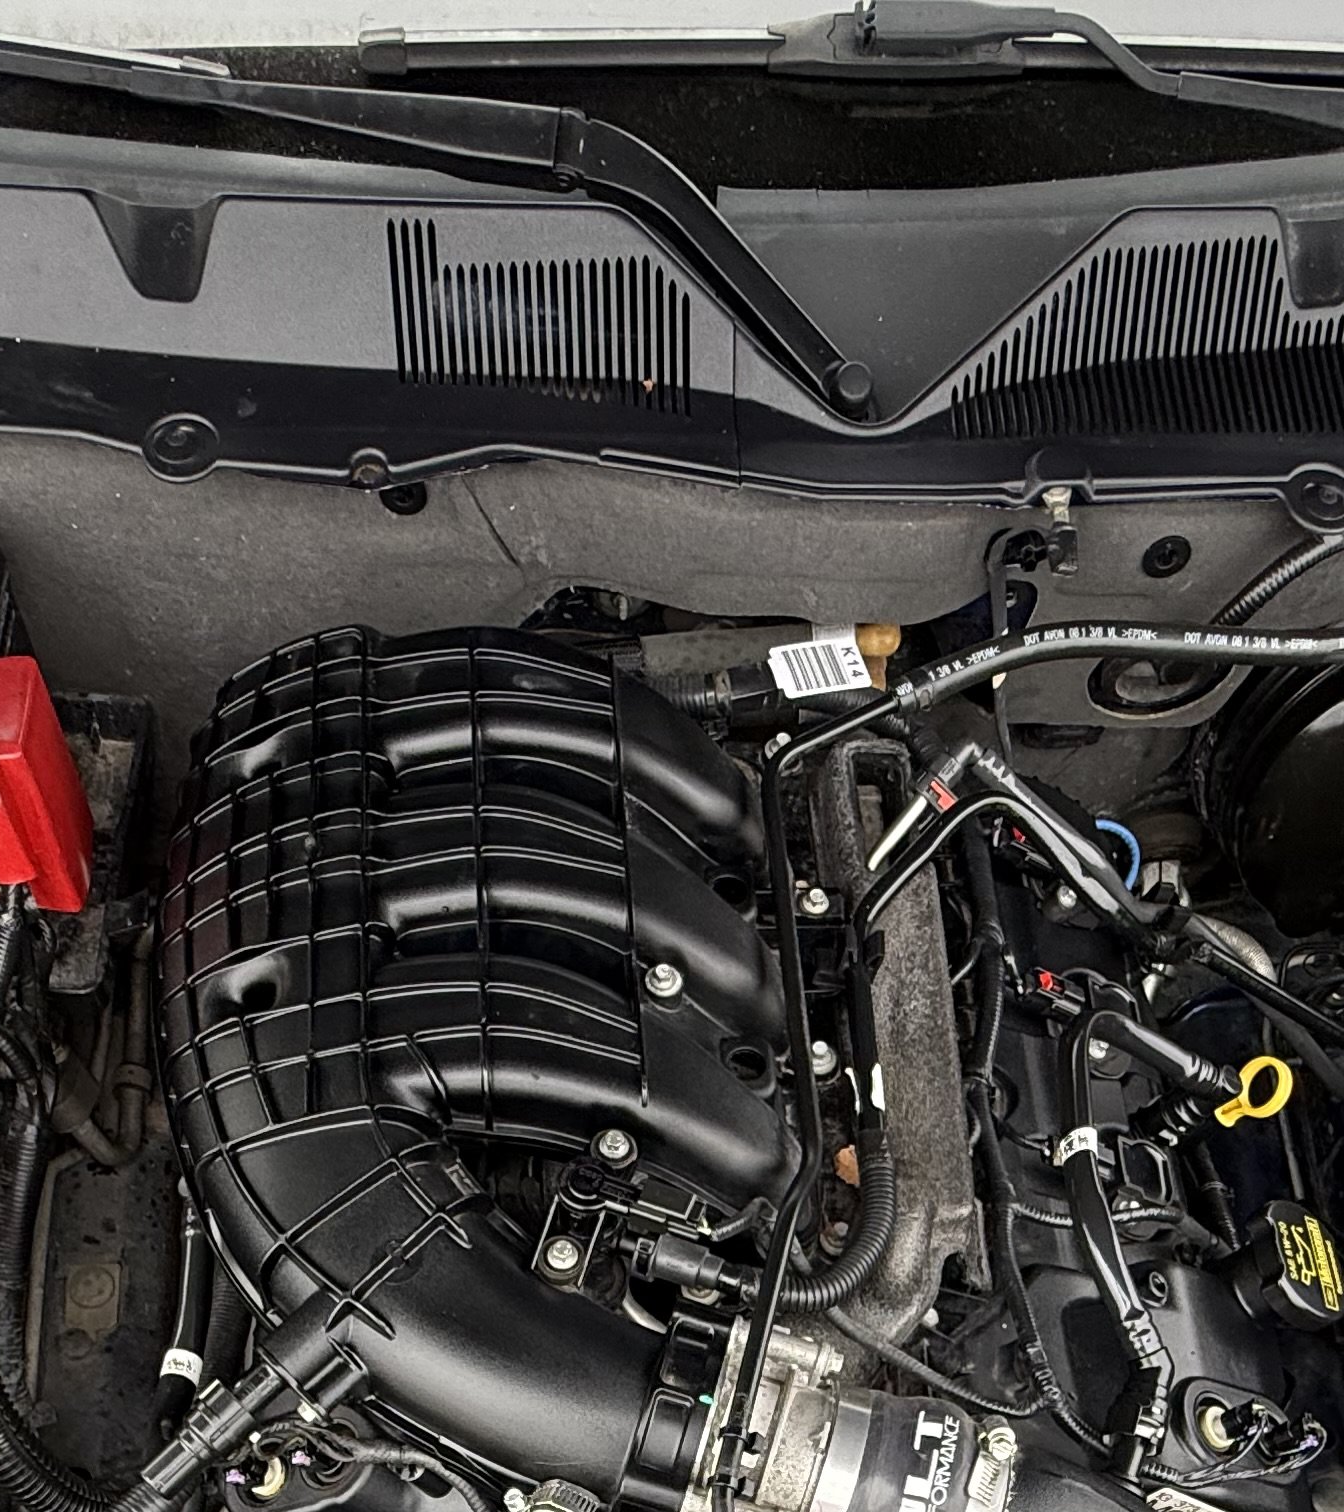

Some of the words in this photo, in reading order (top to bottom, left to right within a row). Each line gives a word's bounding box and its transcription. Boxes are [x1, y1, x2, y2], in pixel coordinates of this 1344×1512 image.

[1023, 632, 1040, 647] DOT
[1044, 628, 1065, 640] AVON
[1089, 626, 1104, 638] 3/8
[1107, 626, 1117, 638] VL
[1184, 632, 1202, 644] DOT
[1204, 633, 1228, 646] AVON
[1252, 637, 1267, 649] 3/8
[936, 664, 951, 678] 3/8
[952, 659, 965, 672] VL
